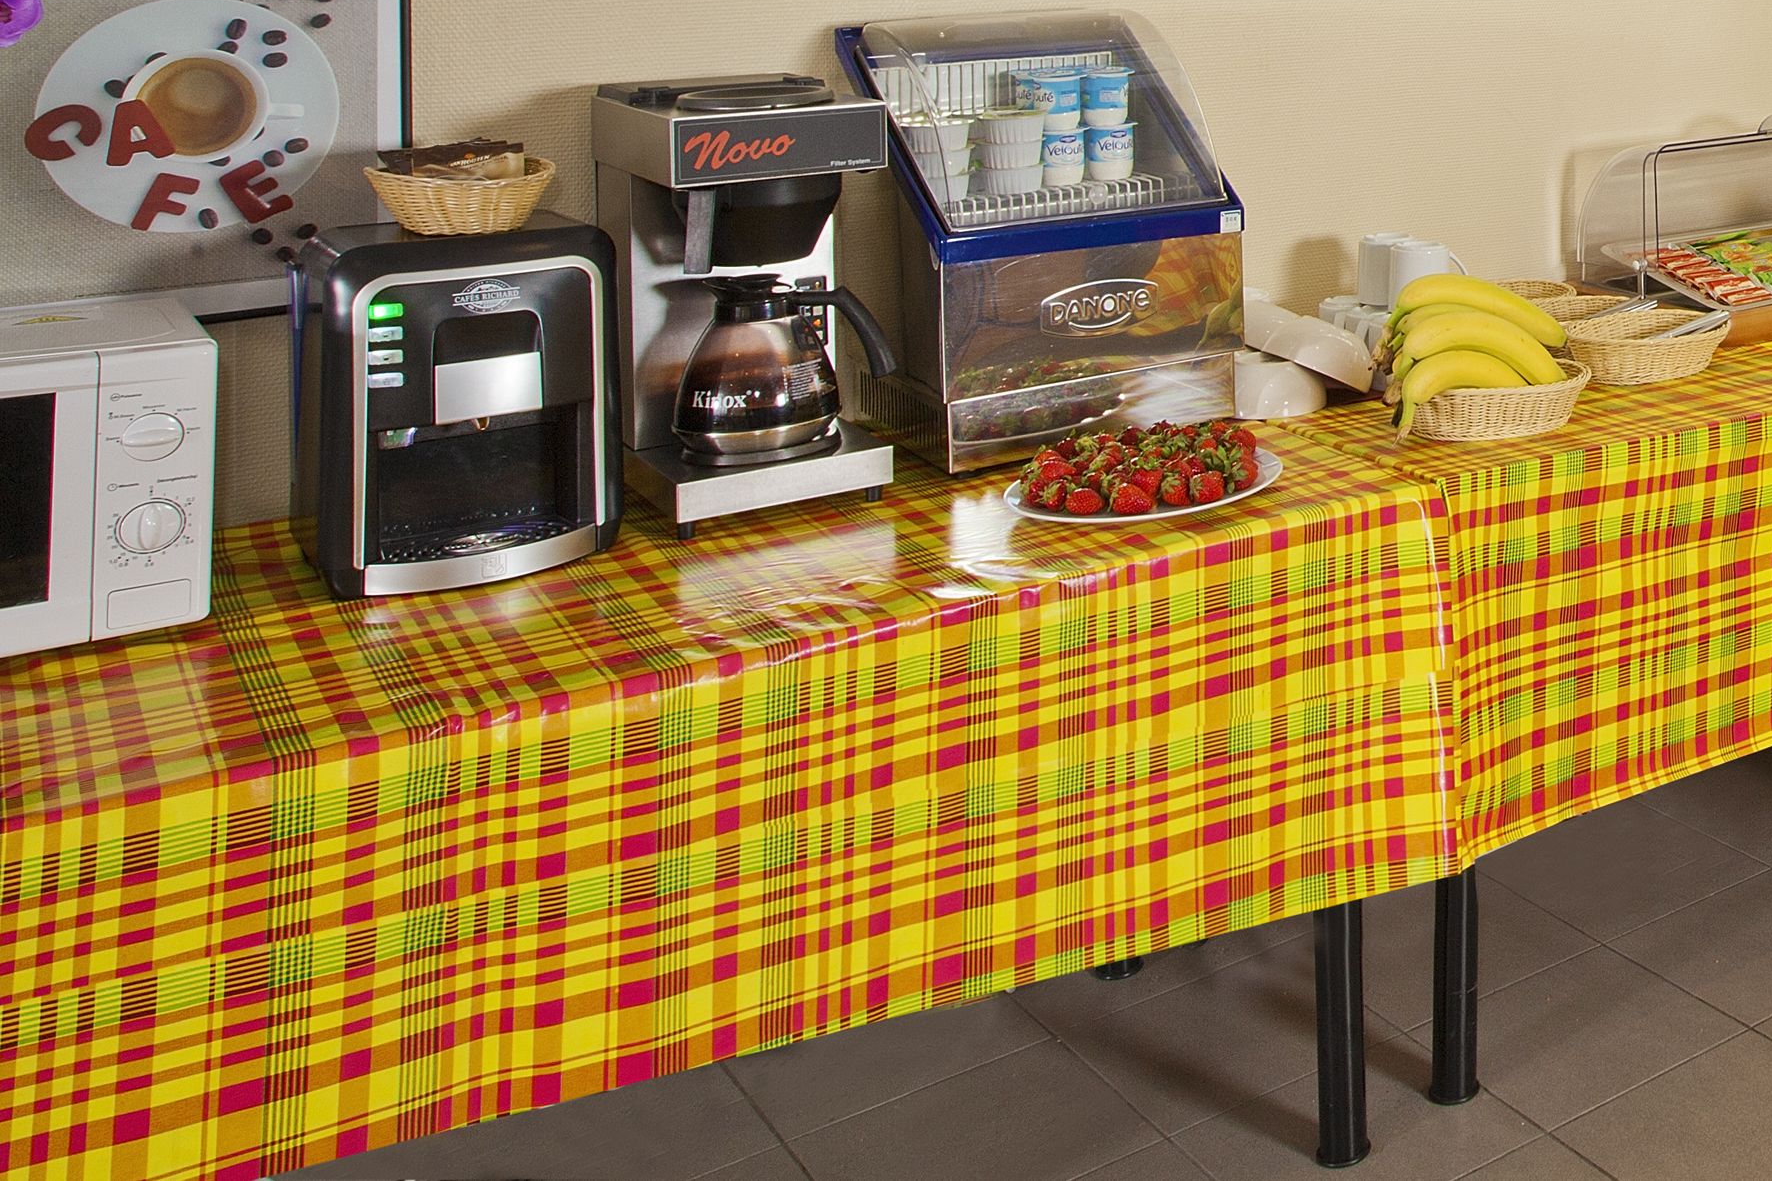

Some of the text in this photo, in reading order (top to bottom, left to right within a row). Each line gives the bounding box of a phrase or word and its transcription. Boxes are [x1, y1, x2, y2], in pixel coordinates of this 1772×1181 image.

[684, 130, 796, 171] Novo
[830, 157, 871, 167] Filter System
[481, 289, 519, 301] RICHARD
